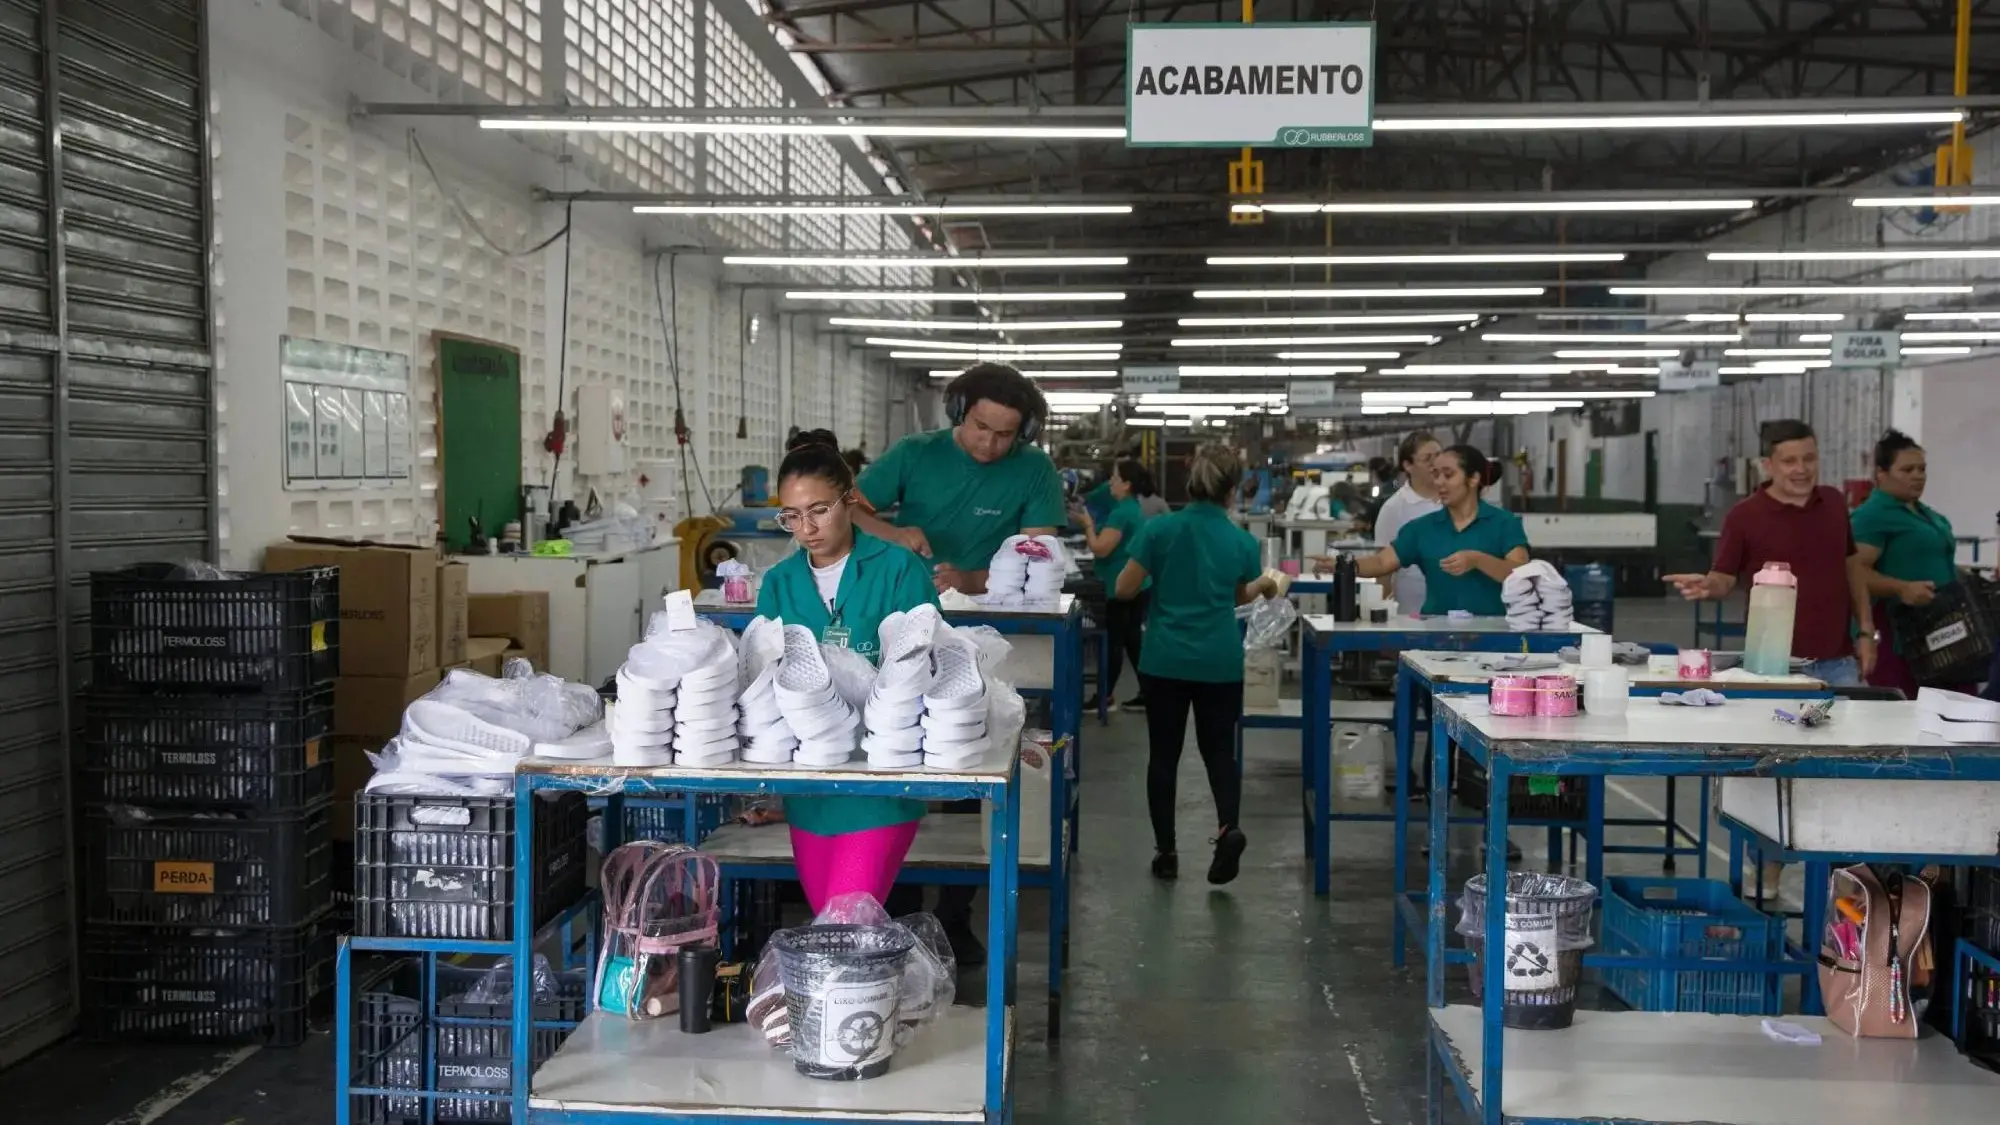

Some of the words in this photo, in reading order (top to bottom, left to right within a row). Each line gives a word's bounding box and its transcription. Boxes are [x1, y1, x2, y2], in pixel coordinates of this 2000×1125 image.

[1135, 64, 1364, 96] ACABAMENTO
[163, 636, 226, 647] TERMOLOSS
[161, 752, 217, 765] TERMOLOSS
[834, 996, 855, 1005] LIXO
[439, 1065, 509, 1079] TERMOLOSS
